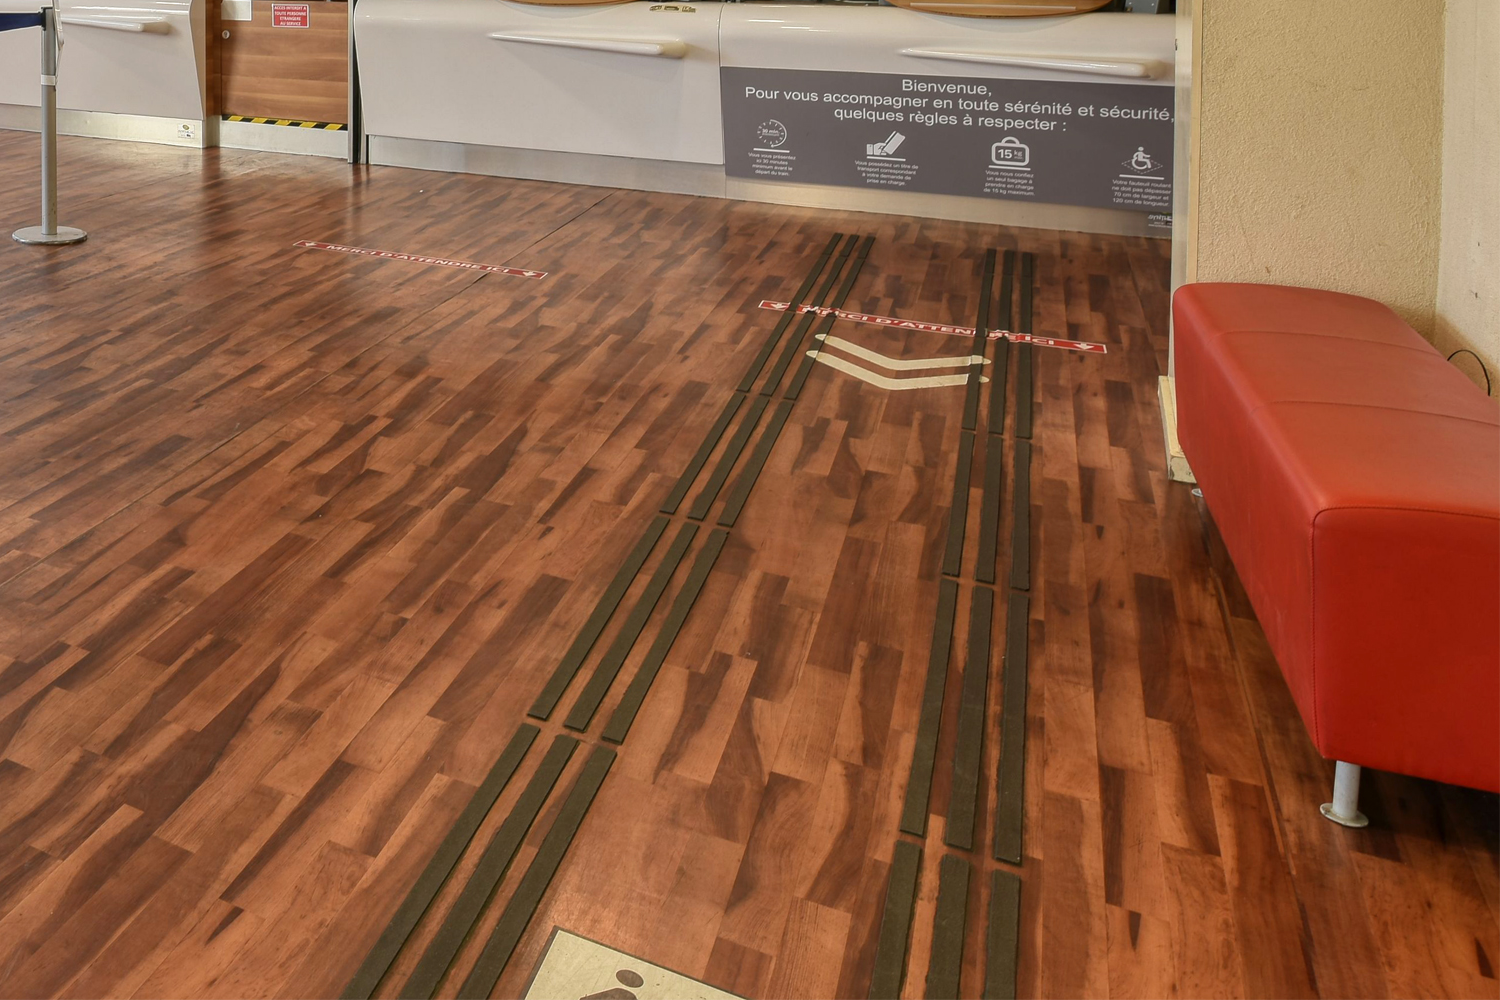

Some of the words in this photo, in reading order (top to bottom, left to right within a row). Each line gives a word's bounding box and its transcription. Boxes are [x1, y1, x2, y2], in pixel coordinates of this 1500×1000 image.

[902, 79, 992, 97] Bienvenue,
[745, 86, 779, 100] Pour
[783, 91, 819, 102] vous
[823, 93, 929, 109] accompagner
[933, 99, 953, 109] en
[958, 98, 999, 112] toute
[1004, 100, 1073, 115] sérénité
[1077, 104, 1095, 117] et
[1100, 104, 1175, 123] sécurité,
[834, 107, 904, 123] quelques
[909, 111, 958, 126] règles
[962, 113, 973, 126] à
[978, 116, 1057, 131] respecter
[997, 149, 1013, 159] 15
[326, 245, 376, 255] MERCI
[379, 252, 480, 268] D'ATTENDRE
[802, 306, 868, 321] MERCI
[875, 318, 1017, 341] D'ATTENRE
[1025, 335, 1054, 345] ICI
